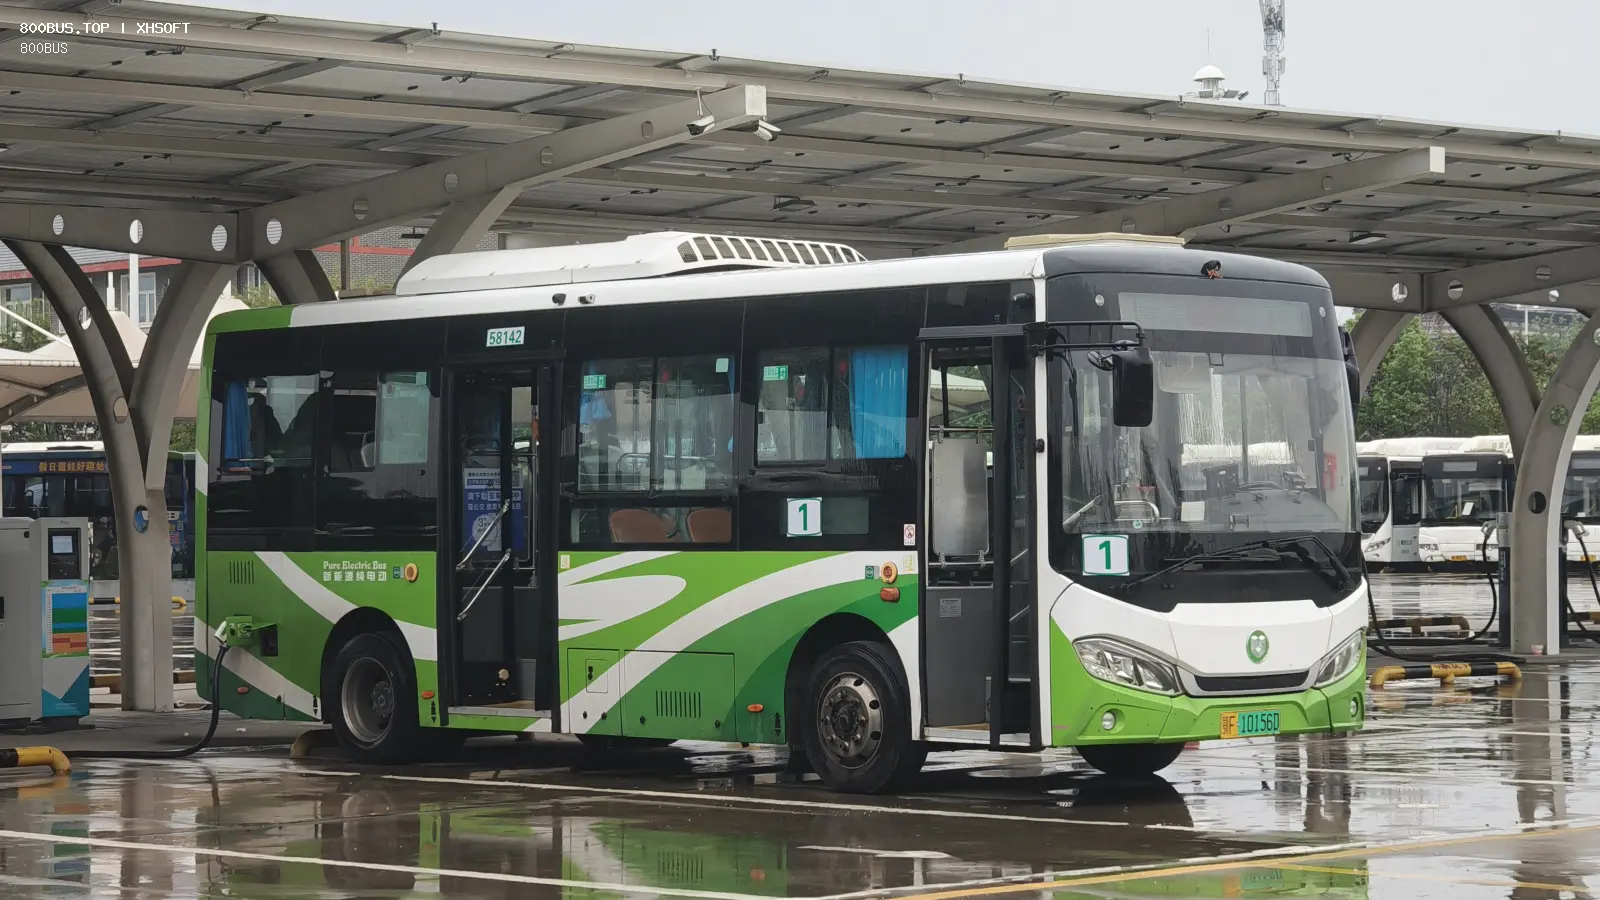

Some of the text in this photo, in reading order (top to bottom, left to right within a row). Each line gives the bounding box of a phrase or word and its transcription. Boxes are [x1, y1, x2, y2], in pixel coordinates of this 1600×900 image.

[489, 329, 522, 345] 58142
[798, 503, 808, 531] 1
[1098, 540, 1112, 570] 1
[323, 561, 387, 570] Pure Electric Bus
[323, 571, 387, 582] 新能源纯电动
